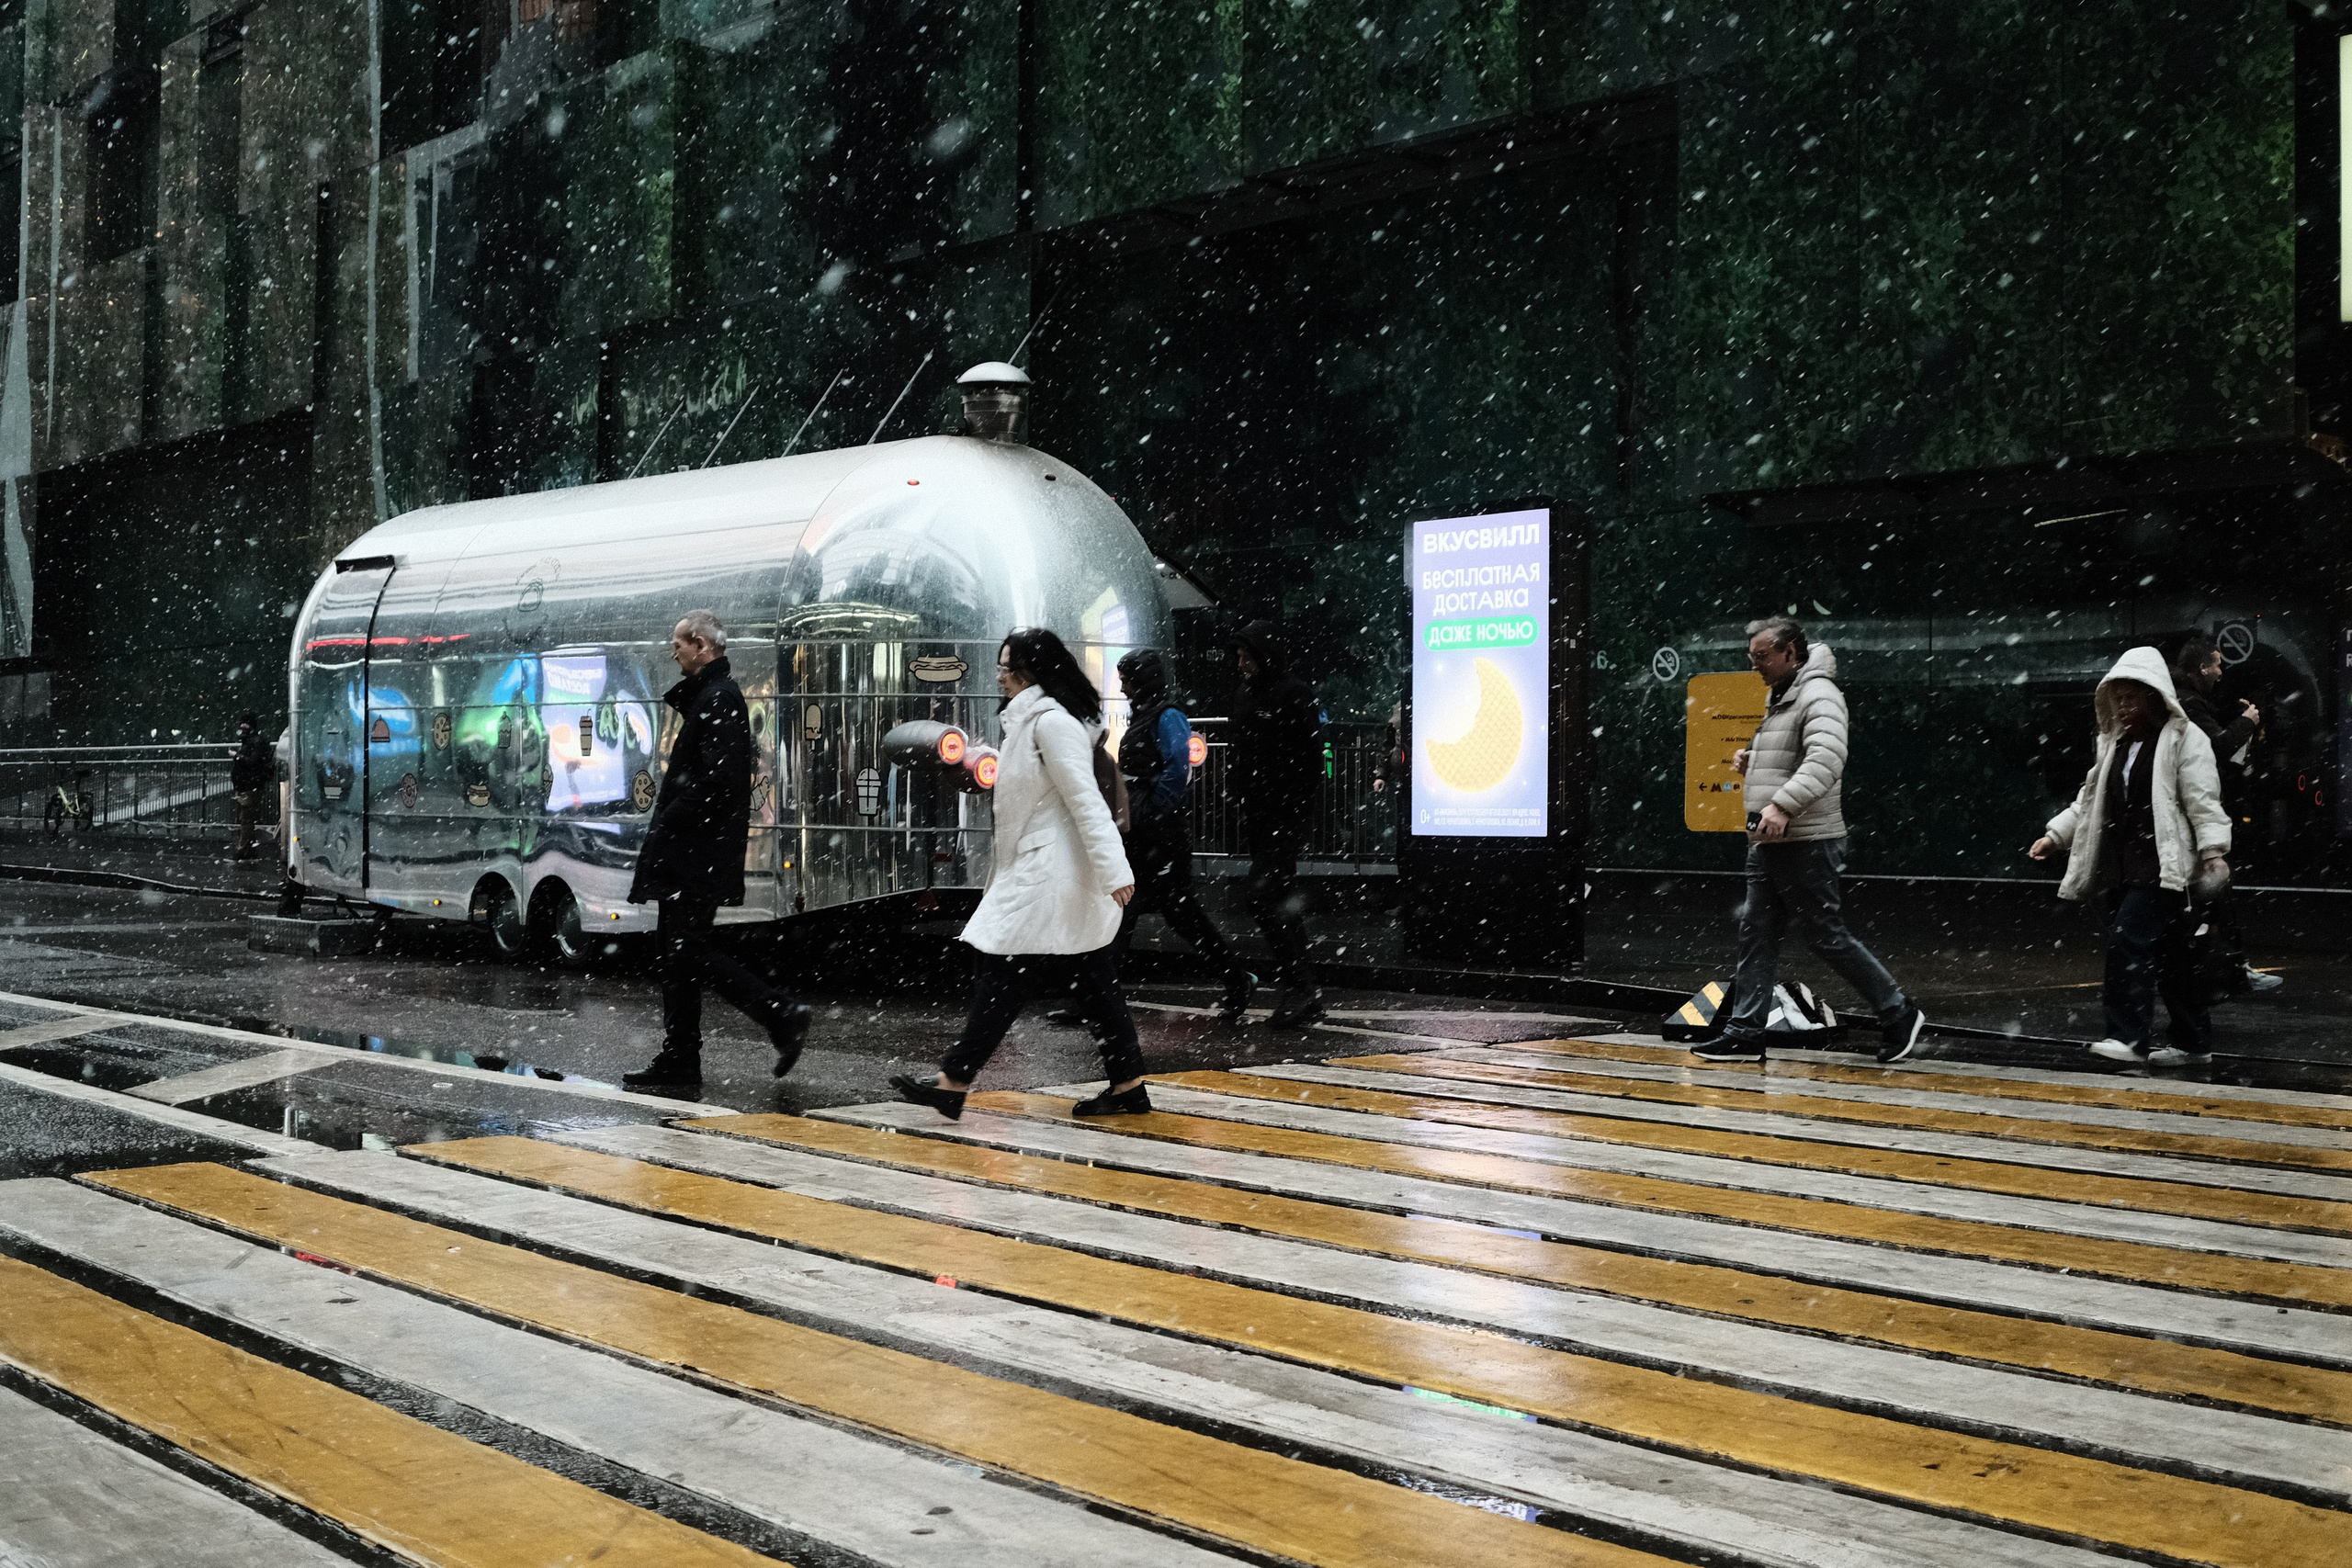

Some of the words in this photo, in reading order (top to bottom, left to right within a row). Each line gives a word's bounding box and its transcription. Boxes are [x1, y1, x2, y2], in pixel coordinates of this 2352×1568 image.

[1424, 523, 1540, 553] ВКУСВИЛЛ
[1476, 621, 1533, 641] НОЧЬЮ
[1420, 808, 1431, 824] 0+
